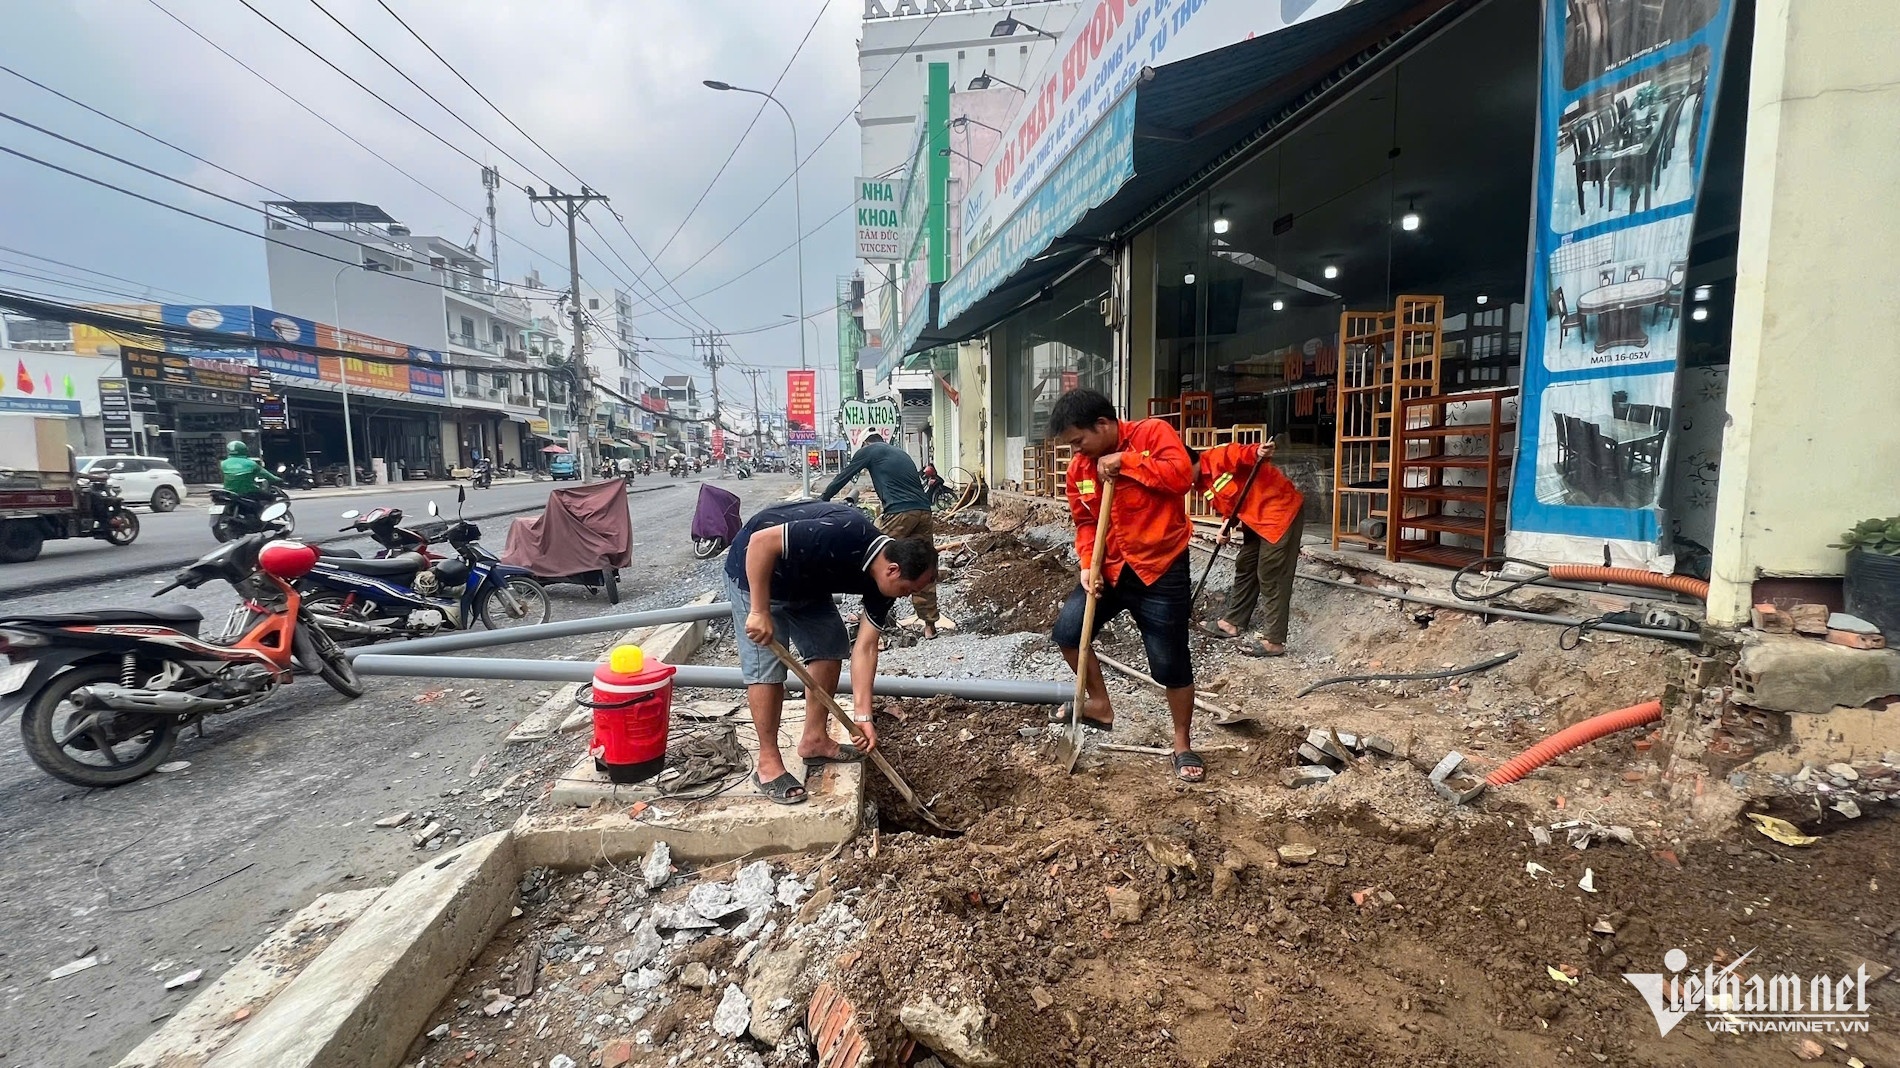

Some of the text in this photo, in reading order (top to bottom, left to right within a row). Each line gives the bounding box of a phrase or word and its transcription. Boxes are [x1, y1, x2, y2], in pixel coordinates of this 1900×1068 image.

[1068, 108, 1075, 129] &
[1077, 84, 1091, 117] THI
[1094, 43, 1123, 96] CÔNG
[994, 139, 1015, 200] NỘI
[1018, 71, 1057, 166] THẤT
[1062, 0, 1138, 105] HƯƠN
[862, 182, 893, 202] NHA
[858, 208, 898, 227] KHOA
[859, 228, 899, 241] TÂM ĐỨC
[861, 243, 898, 253] VINCENT
[845, 406, 894, 425] NHA KHOA
